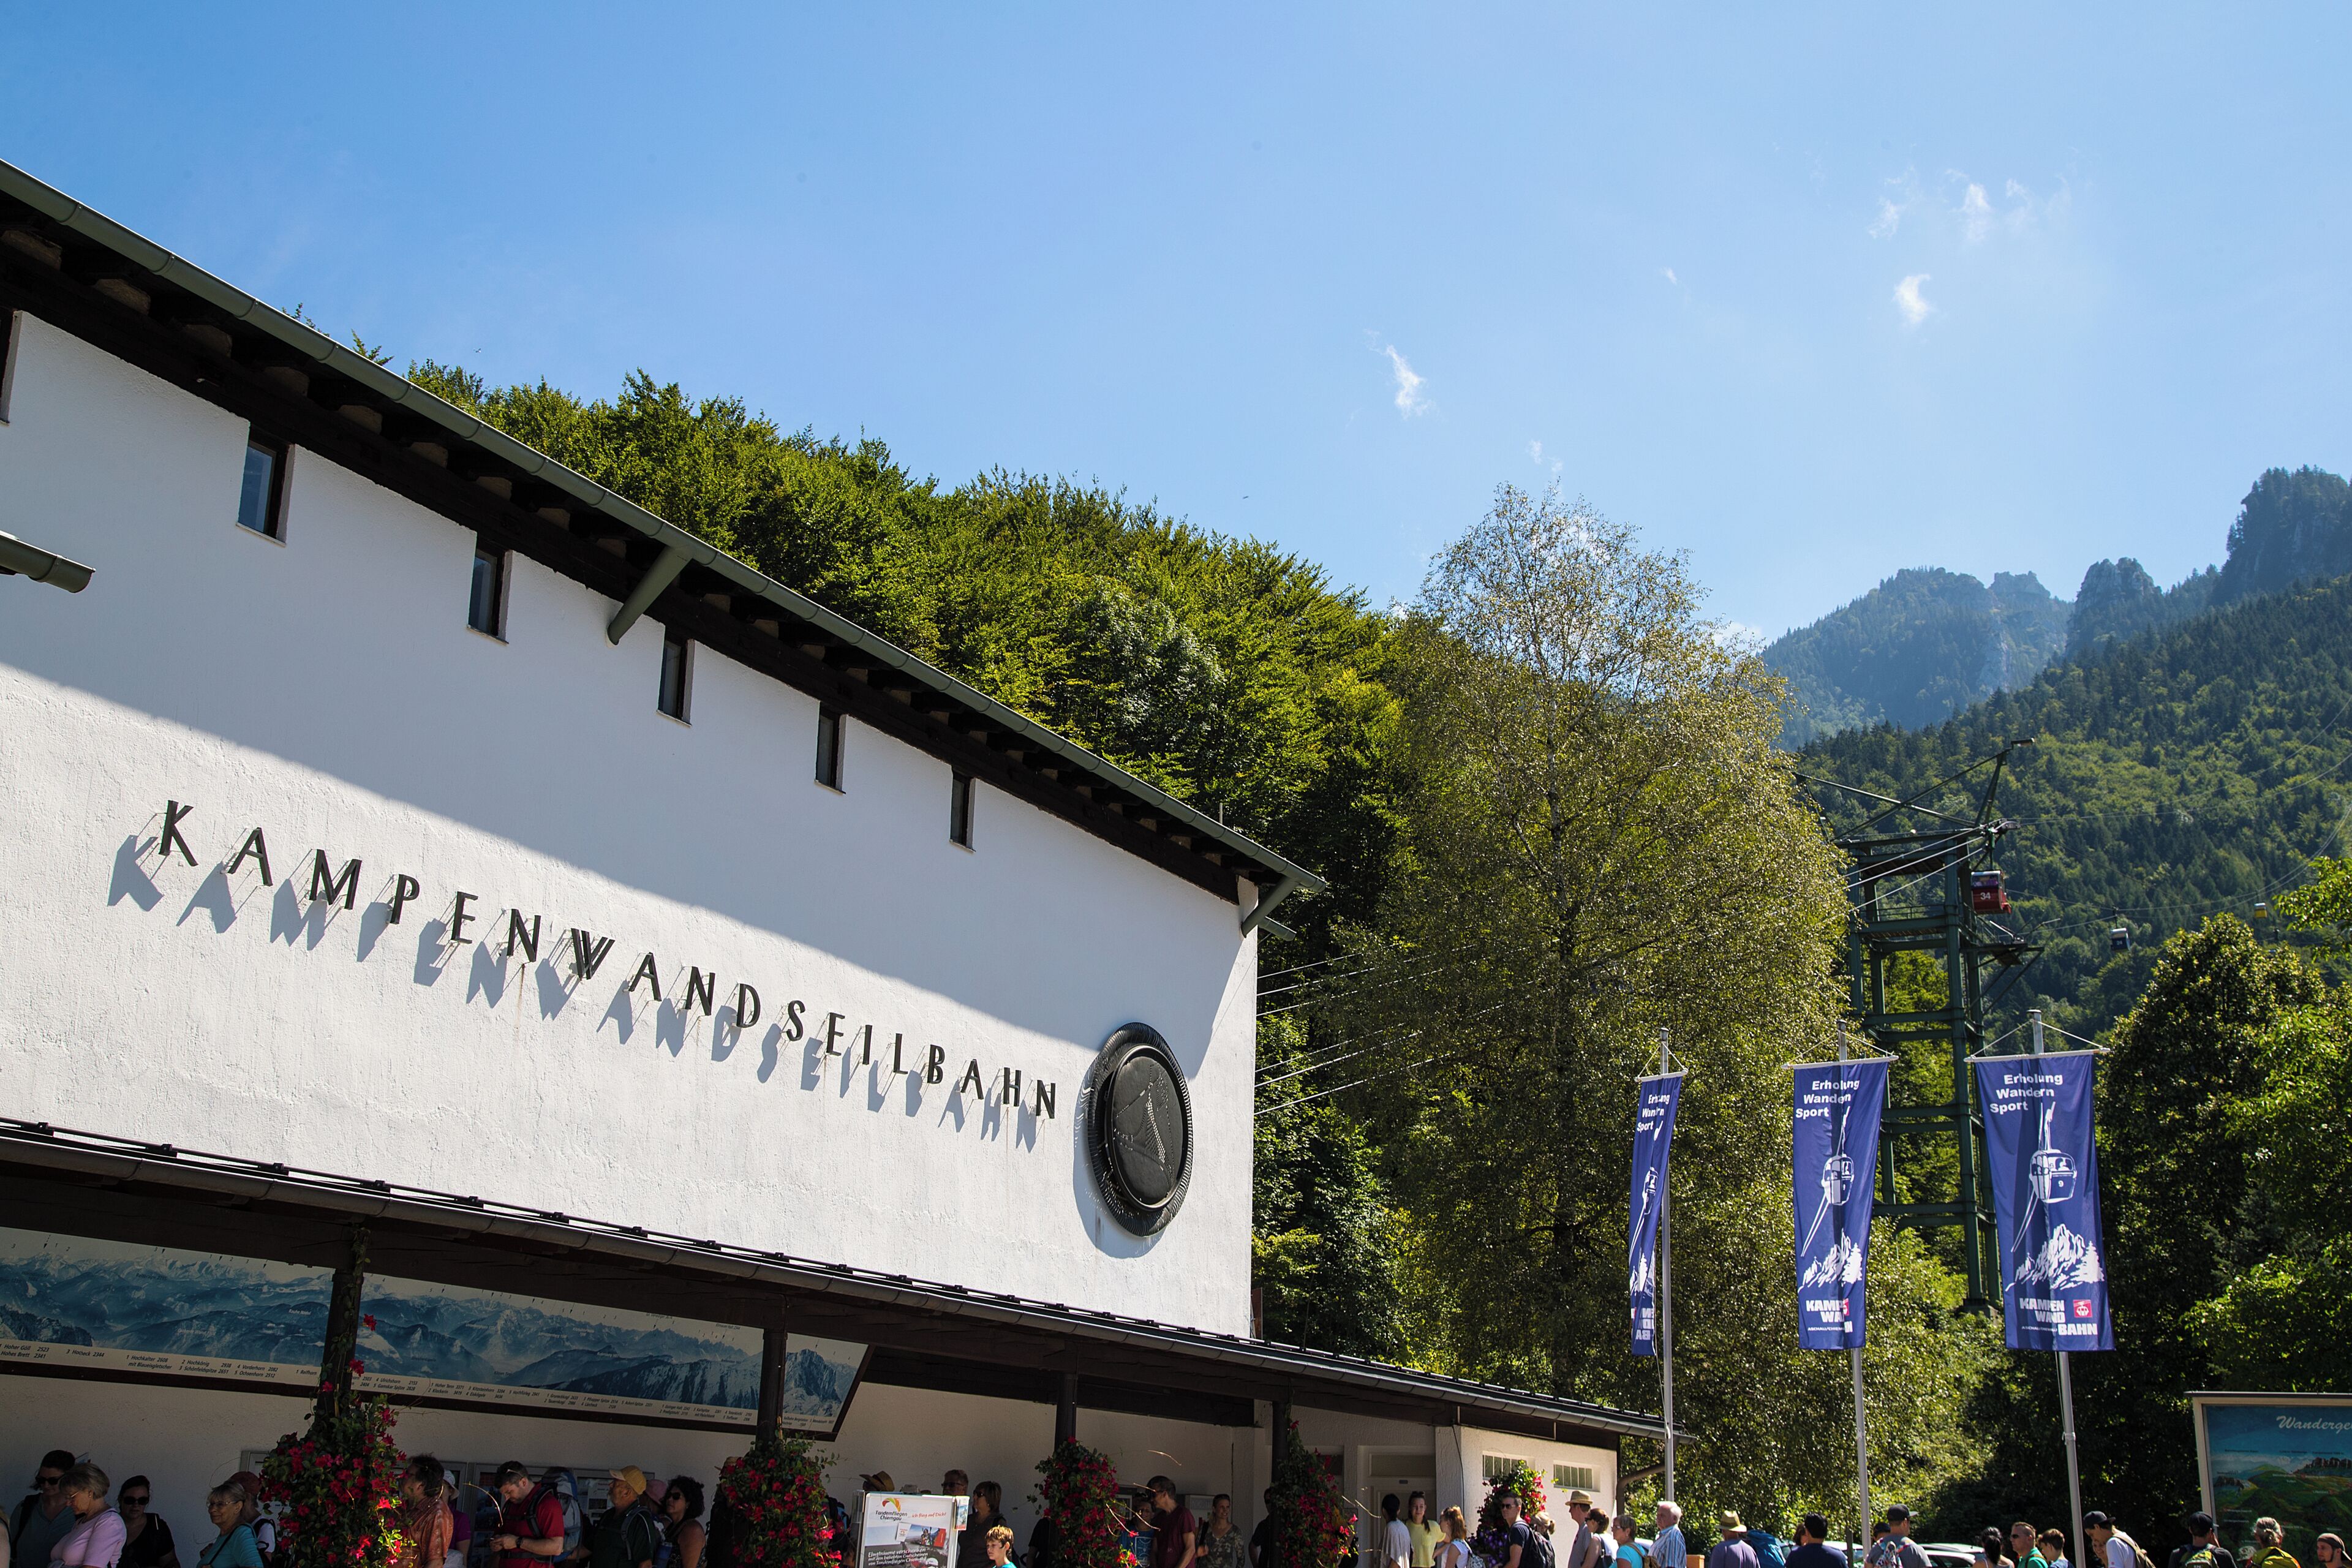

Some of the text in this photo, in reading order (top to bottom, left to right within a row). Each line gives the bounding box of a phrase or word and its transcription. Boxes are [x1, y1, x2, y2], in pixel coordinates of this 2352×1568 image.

[159, 799, 1056, 1119] KAMPENWANDSEILBAHN
[1812, 1080, 1860, 1090] Erholung
[2003, 1073, 2063, 1085] Erholung
[1996, 1087, 2054, 1099] Wandern
[1795, 1107, 1830, 1120] Sport
[1989, 1101, 2029, 1115] Sport
[1637, 1120, 1654, 1133] Sport
[2019, 1298, 2065, 1311] KAMPEN
[2035, 1310, 2065, 1324] WAND
[2057, 1323, 2098, 1335] BAHN
[2276, 1415, 2352, 1434] Wanderge
